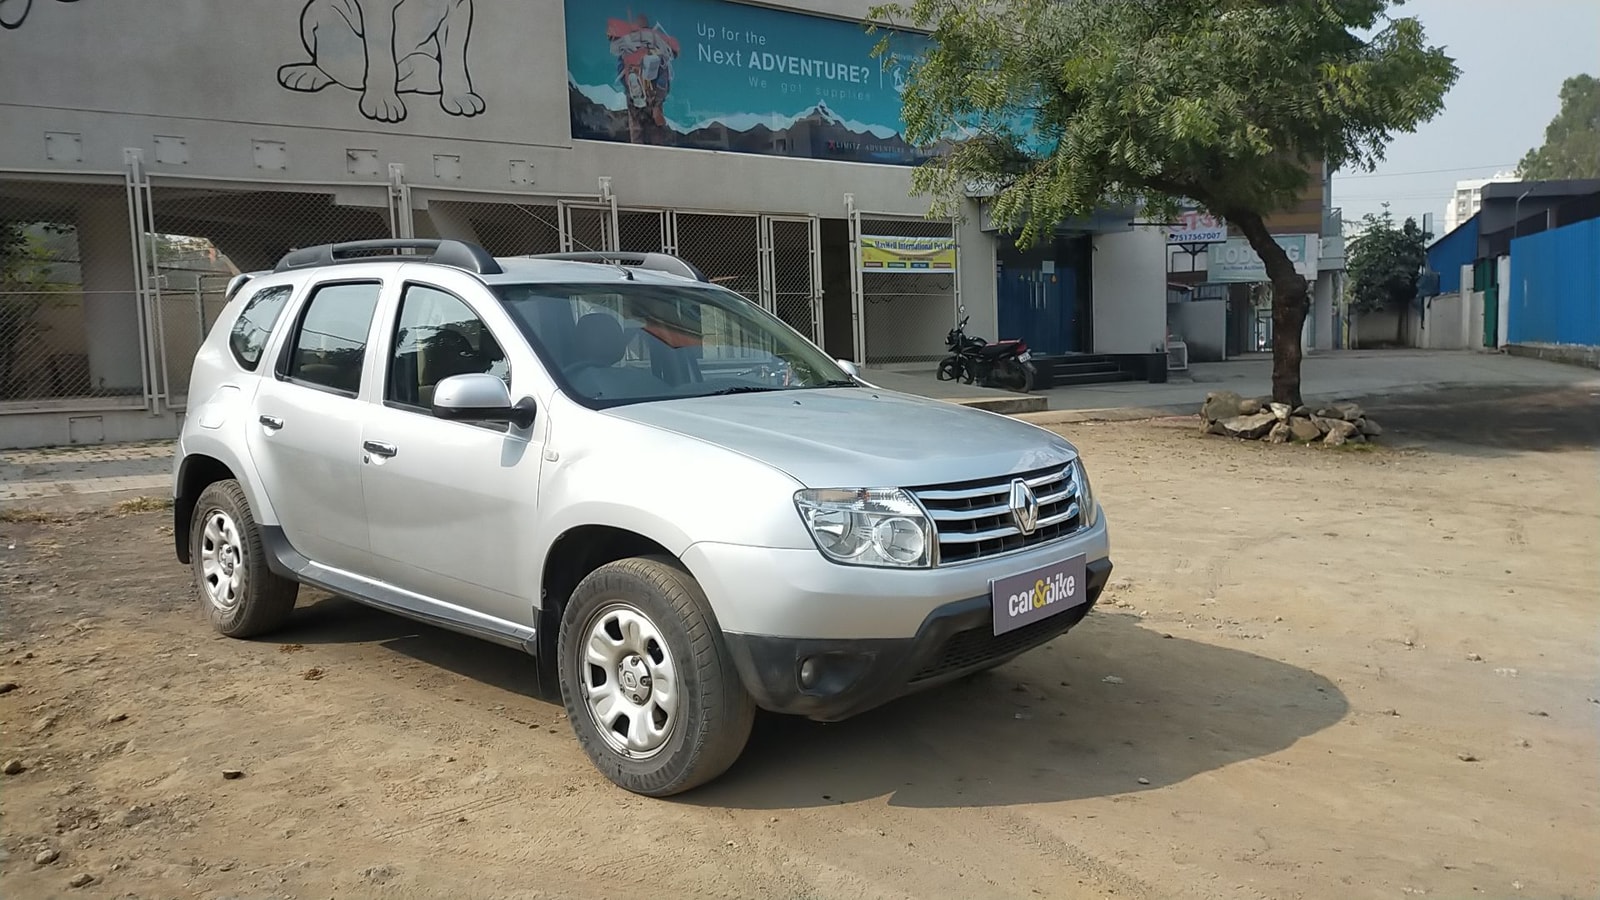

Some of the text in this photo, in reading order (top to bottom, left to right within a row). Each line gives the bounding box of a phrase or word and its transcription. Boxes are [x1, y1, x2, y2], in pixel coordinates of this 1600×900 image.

[697, 23, 767, 45] Up for the
[698, 43, 870, 84] Next ADVENTURE?
[748, 76, 767, 88] We
[781, 81, 802, 94] got
[898, 241, 933, 250] International
[1008, 572, 1075, 617] car&bike
